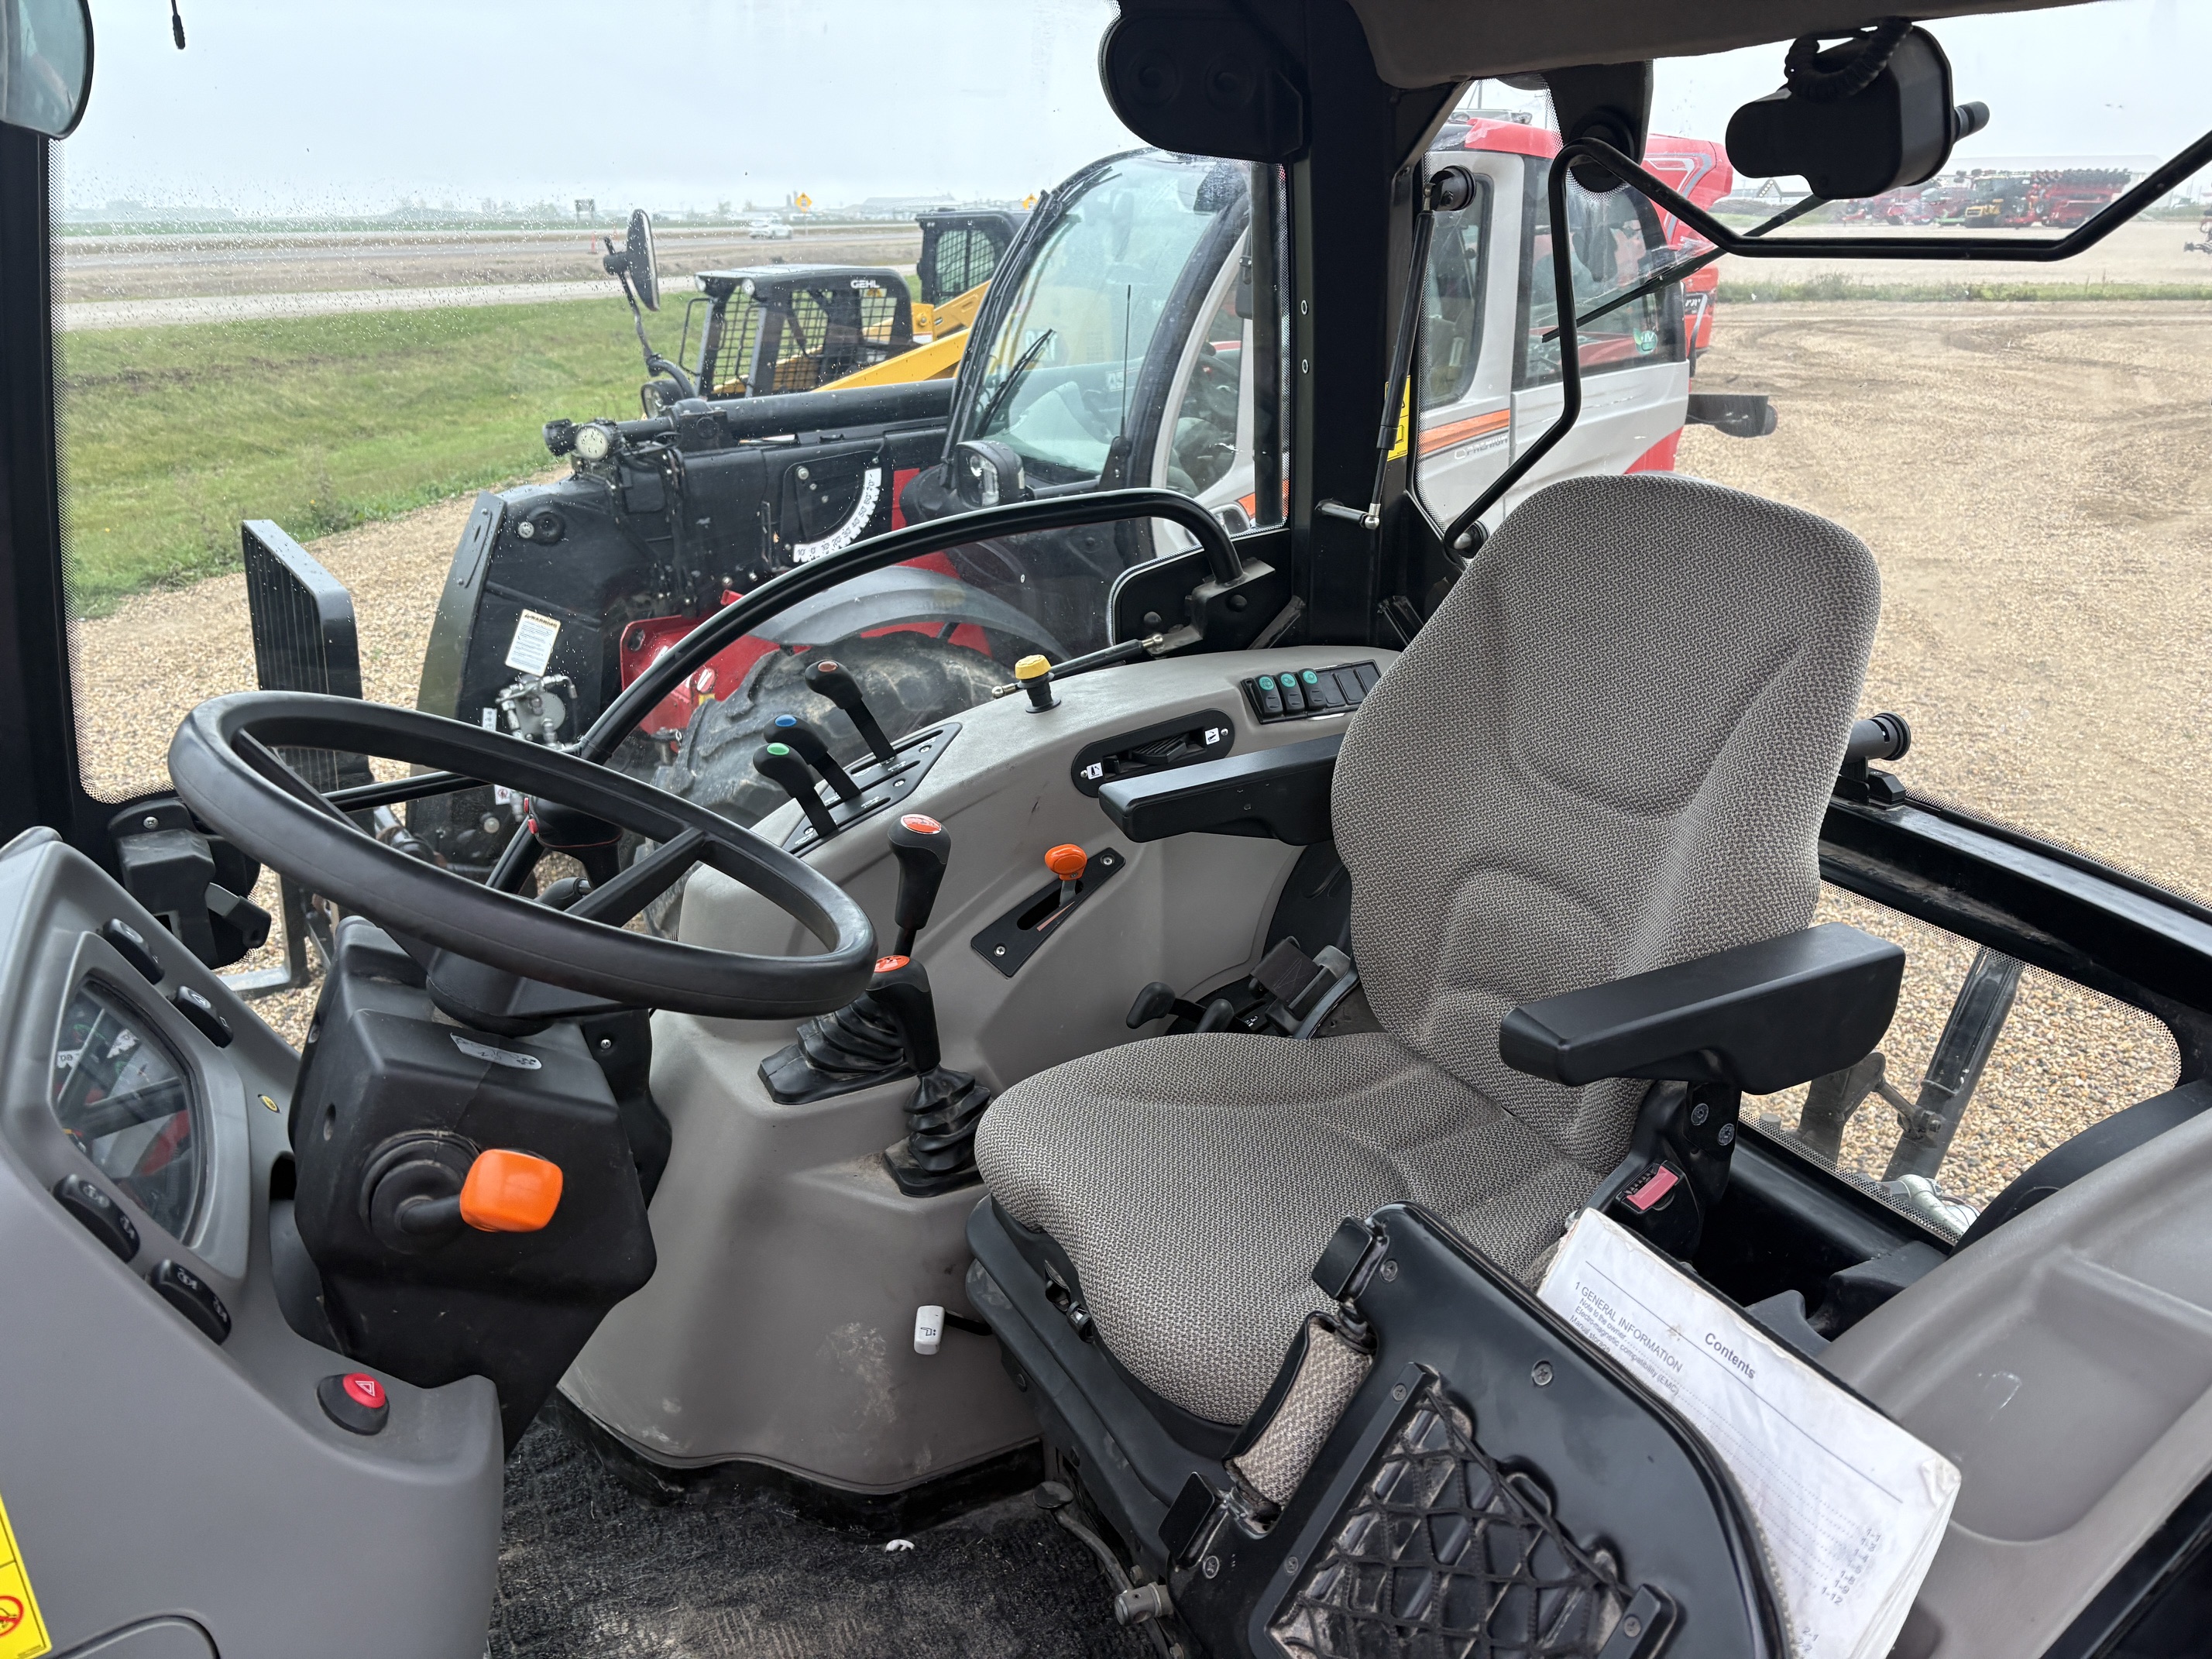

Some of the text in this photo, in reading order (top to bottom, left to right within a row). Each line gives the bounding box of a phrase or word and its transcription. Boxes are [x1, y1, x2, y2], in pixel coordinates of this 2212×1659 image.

[850, 280, 881, 289] GEHL
[1592, 1309, 1599, 1317] to
[1569, 1314, 1590, 1334] Manual
[1575, 1281, 1684, 1373] 1 GENERAL INFORMATION
[1705, 1332, 1756, 1379] Contents
[1657, 1374, 1680, 1396] (EMC)
[1822, 1586, 1843, 1605] 1-12
[1802, 1626, 1819, 1642] 2-1
